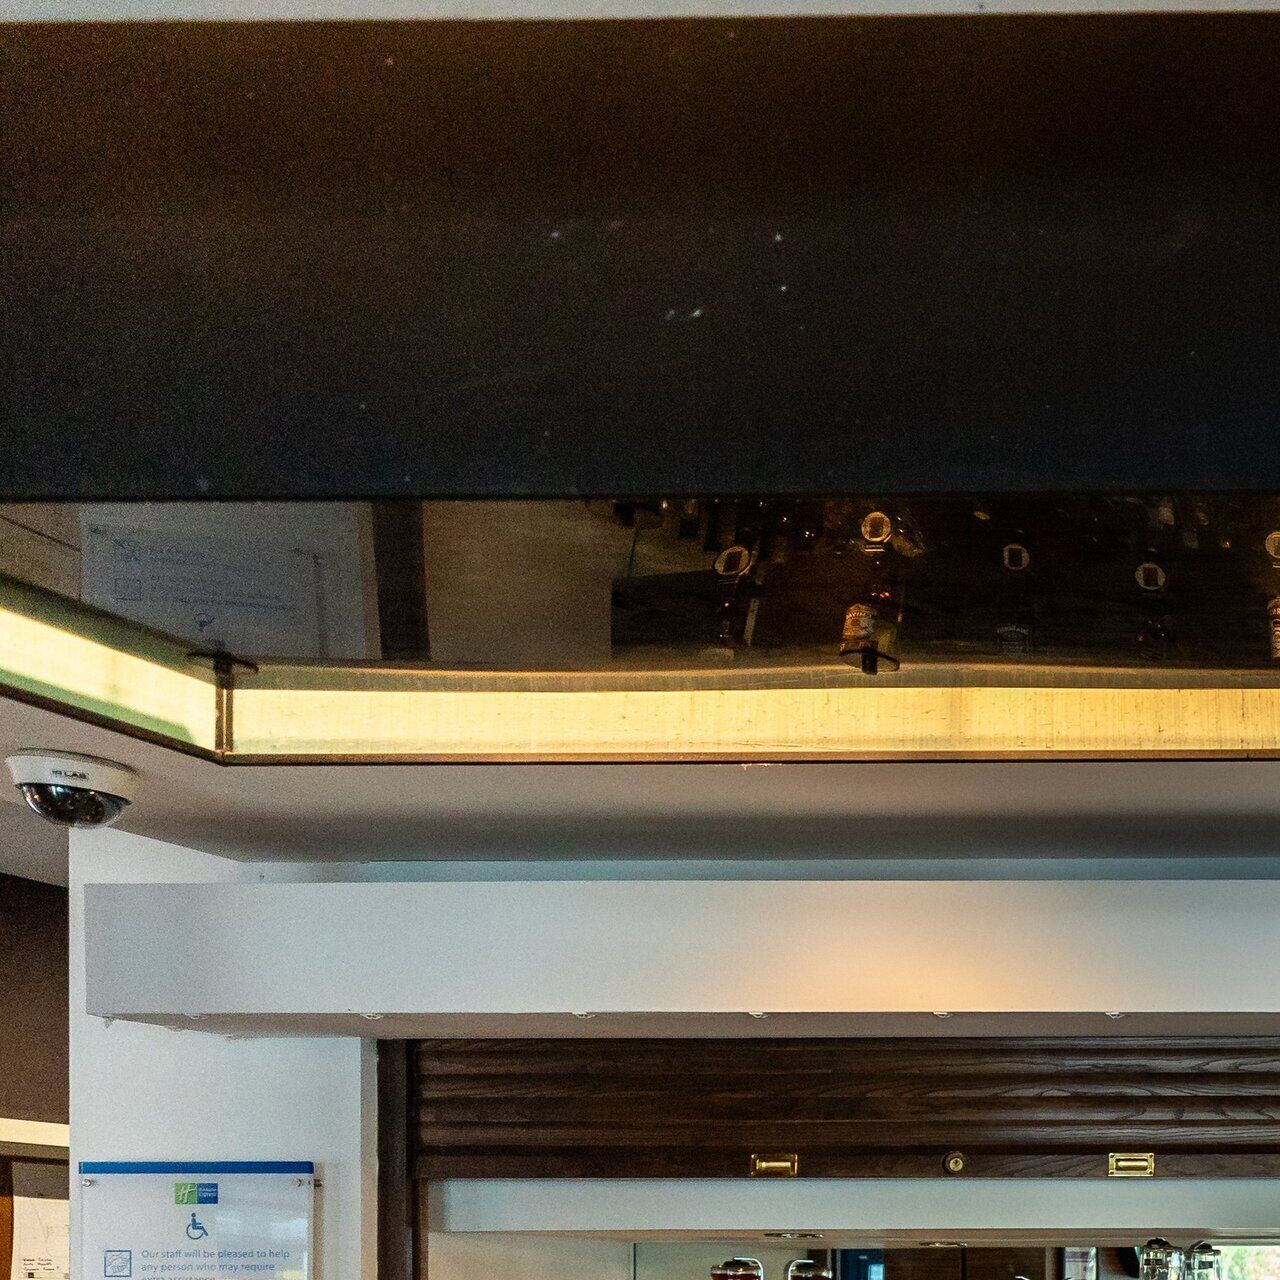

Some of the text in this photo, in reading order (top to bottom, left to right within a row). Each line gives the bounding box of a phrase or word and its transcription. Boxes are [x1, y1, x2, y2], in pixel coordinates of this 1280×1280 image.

[161, 1250, 182, 1258] staff
[184, 1250, 200, 1258] will
[203, 1250, 215, 1258] be
[217, 1250, 254, 1260] pleased
[268, 1250, 290, 1260] help
[141, 1262, 275, 1272] any person who may require
